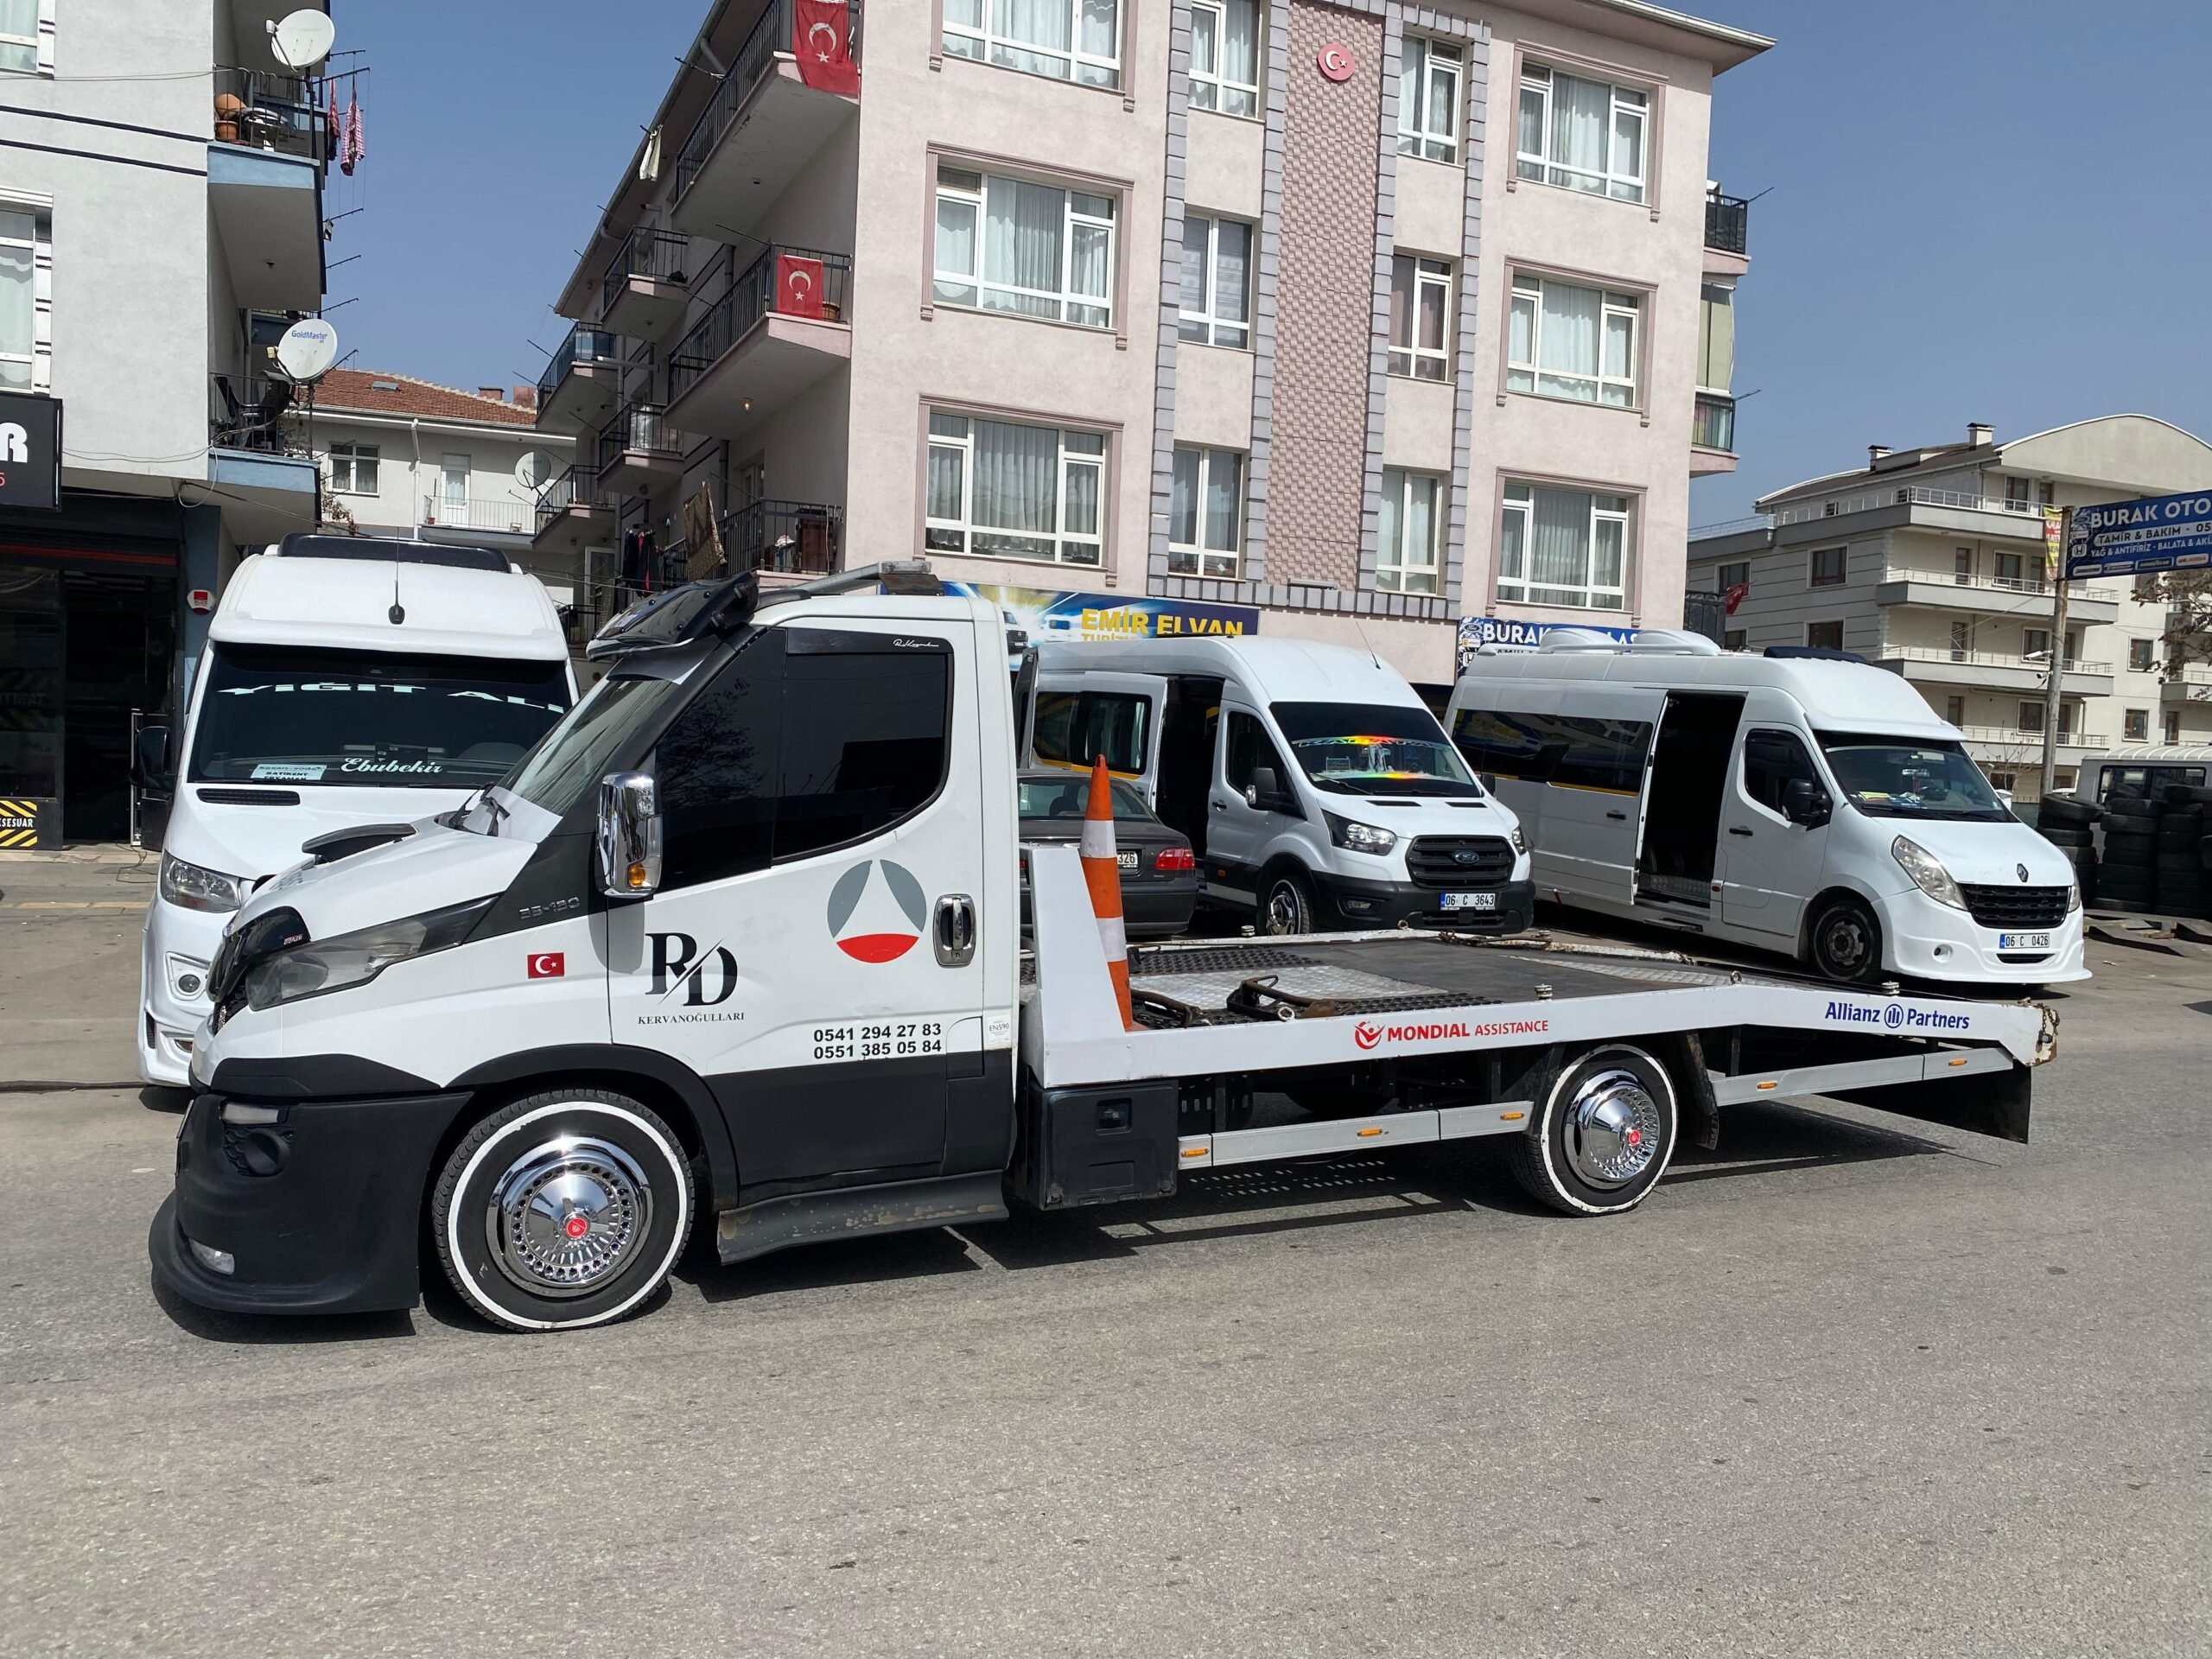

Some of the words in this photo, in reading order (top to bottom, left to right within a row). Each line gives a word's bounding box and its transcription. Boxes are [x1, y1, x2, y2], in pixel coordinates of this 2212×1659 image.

[291, 330, 327, 340] GoldMaster
[2091, 504, 2158, 529] BURAK
[2164, 497, 2212, 518] OTO
[2098, 531, 2131, 544] TAMİR
[2134, 531, 2142, 540] &
[2145, 525, 2181, 539] BAKIM
[2091, 547, 2106, 558] YAĞ
[2114, 543, 2152, 556] ANTİFİRİZ
[2158, 539, 2186, 550] BALATA
[1081, 607, 1149, 635] EMİR
[1483, 623, 1552, 645] BURAK
[340, 757, 443, 772] Ebubekir
[1446, 894, 1456, 906] 06
[1462, 894, 1468, 906] C
[1475, 894, 1494, 906] 3643
[2005, 936, 2015, 947] 06
[2019, 936, 2024, 946] C
[2031, 935, 2049, 946] 0426
[638, 1012, 745, 1025] KERVANOĞULLARI
[1825, 1001, 1881, 1023] Allianz
[1906, 1007, 1970, 1030] Partners
[813, 1027, 855, 1043] 0541
[861, 1025, 892, 1040] 294
[896, 1024, 917, 1038] 27
[922, 1023, 942, 1036] 83
[988, 1022, 1010, 1032] EN590
[1388, 1023, 1470, 1042] MONDIAL
[1474, 1020, 1549, 1036] ASSISTANCE
[813, 1044, 855, 1059] 0551
[861, 1042, 892, 1057] 385
[897, 1040, 917, 1054] 05
[922, 1039, 942, 1052] 84
